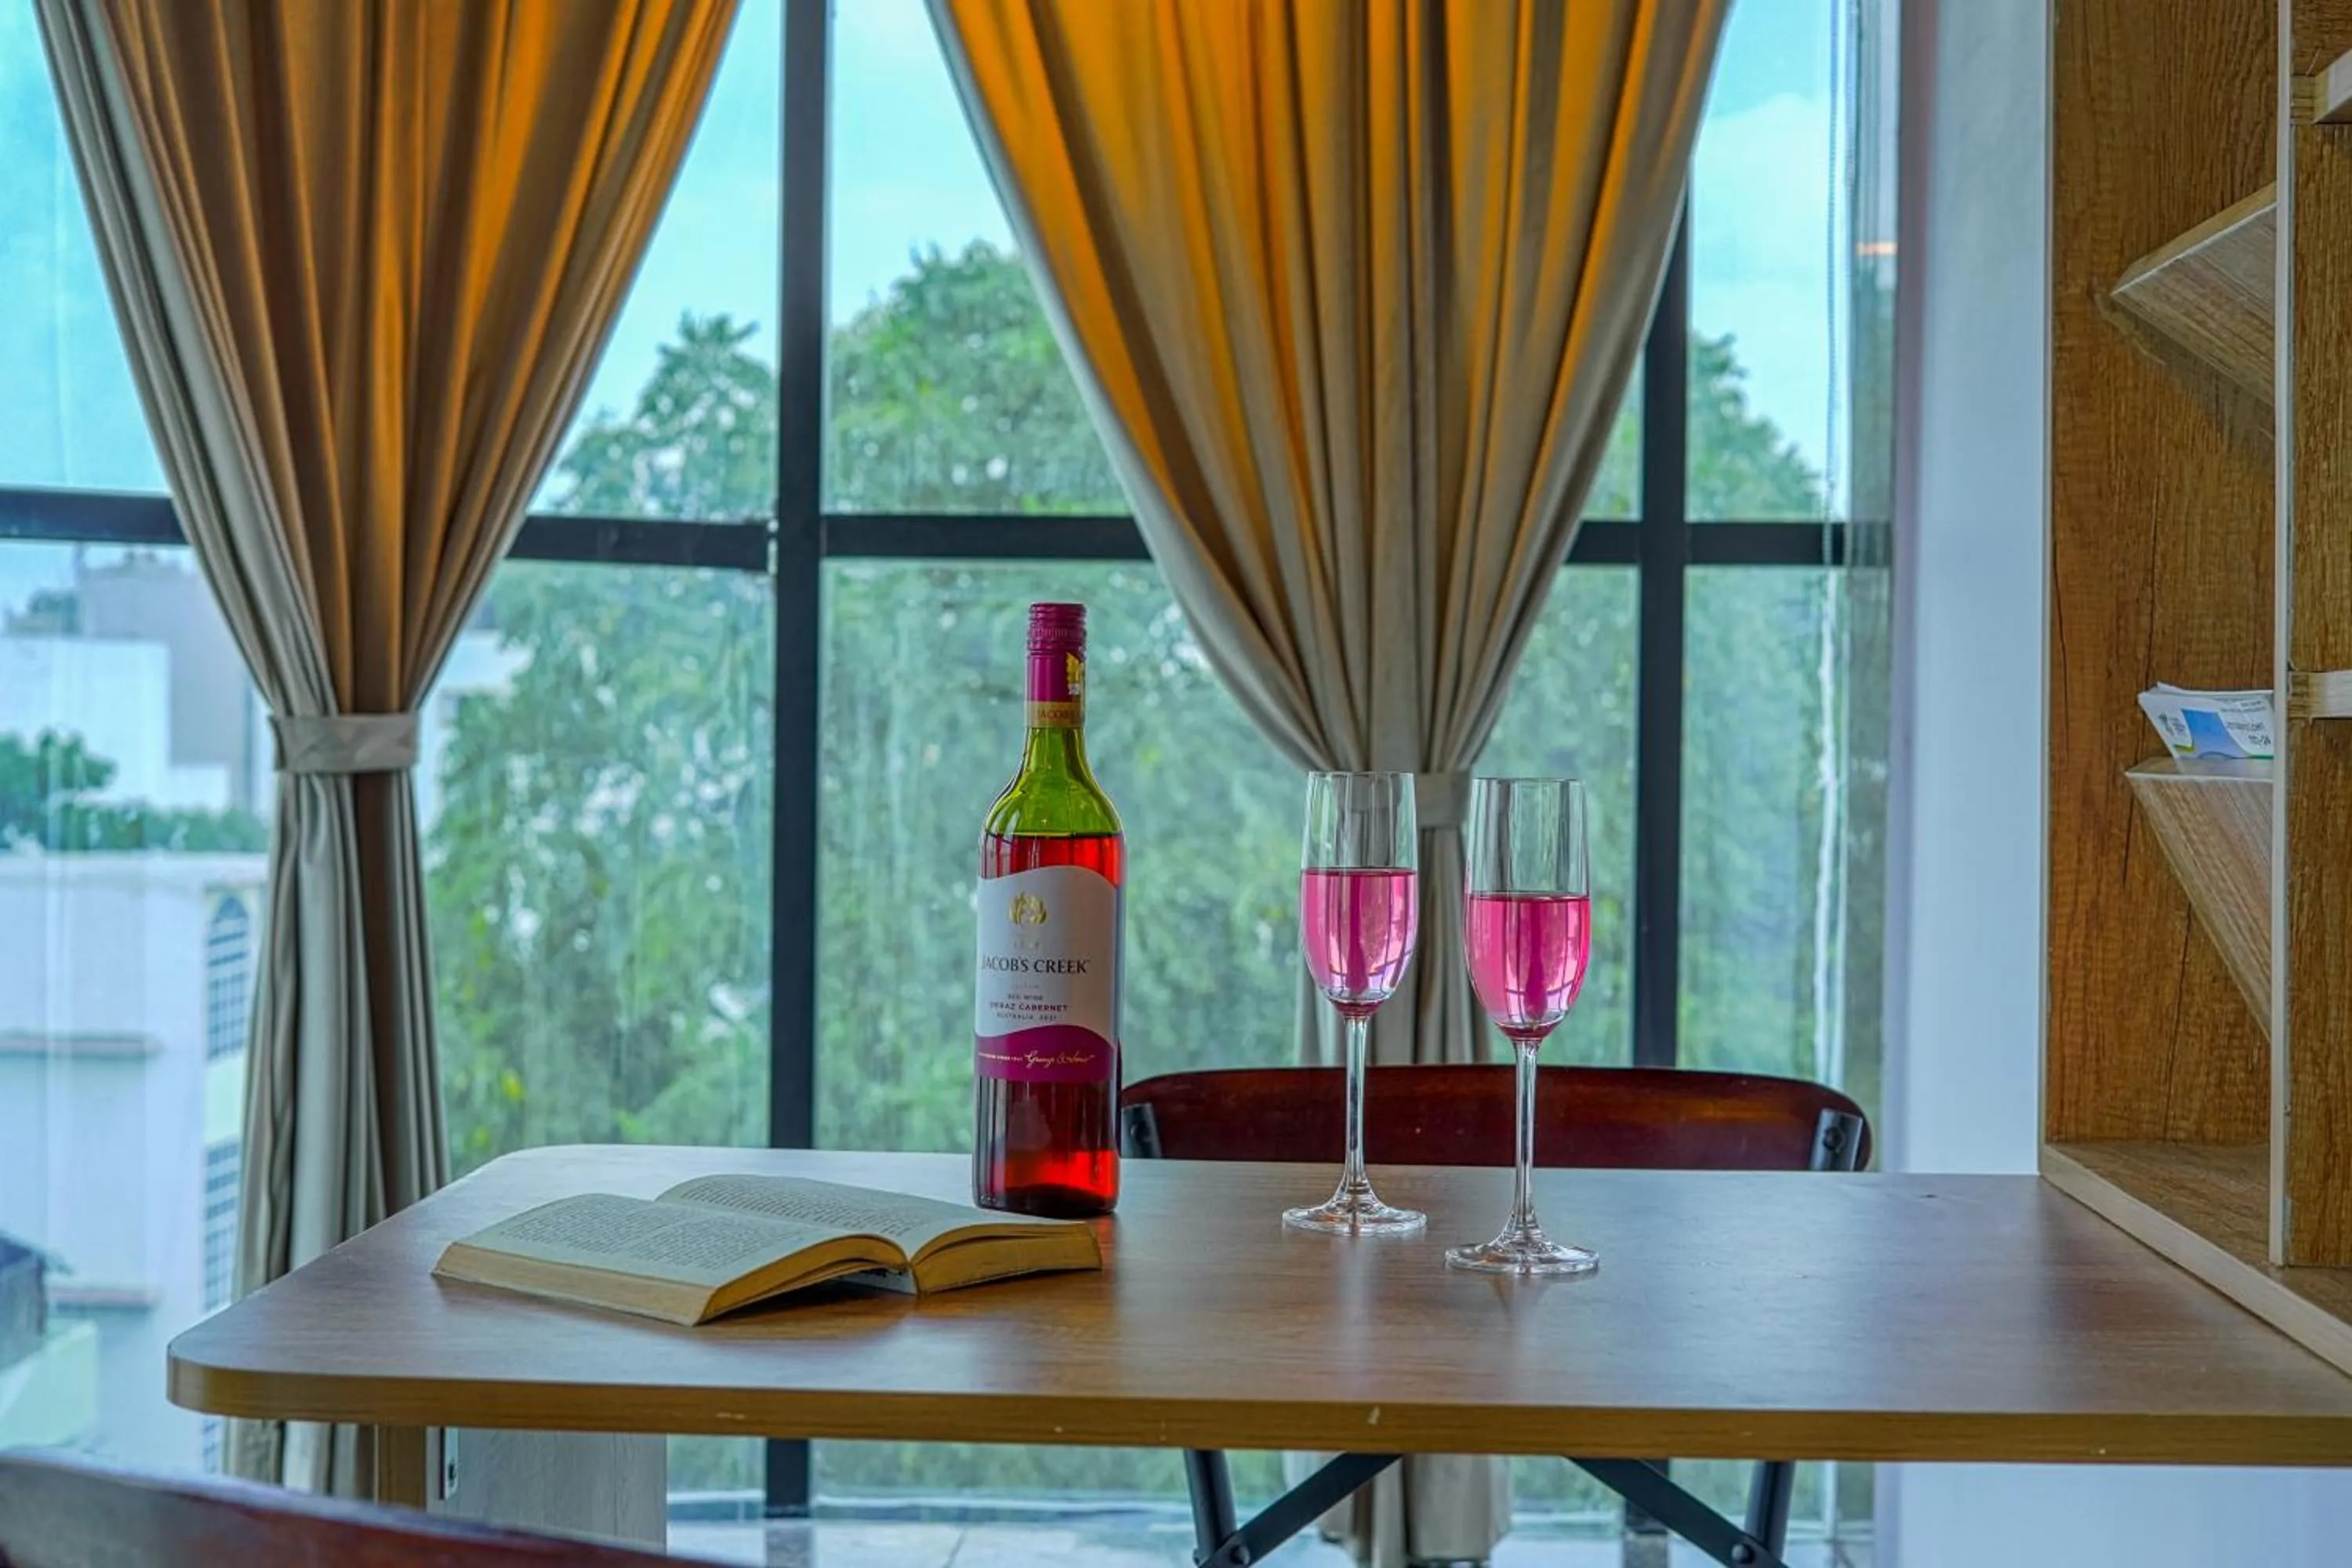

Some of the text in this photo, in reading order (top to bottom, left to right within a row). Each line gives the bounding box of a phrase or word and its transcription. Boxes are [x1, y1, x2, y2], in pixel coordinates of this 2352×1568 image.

[981, 955, 1087, 974] JACOB'S CREEK
[1018, 1004, 1067, 1012] CABERNET
